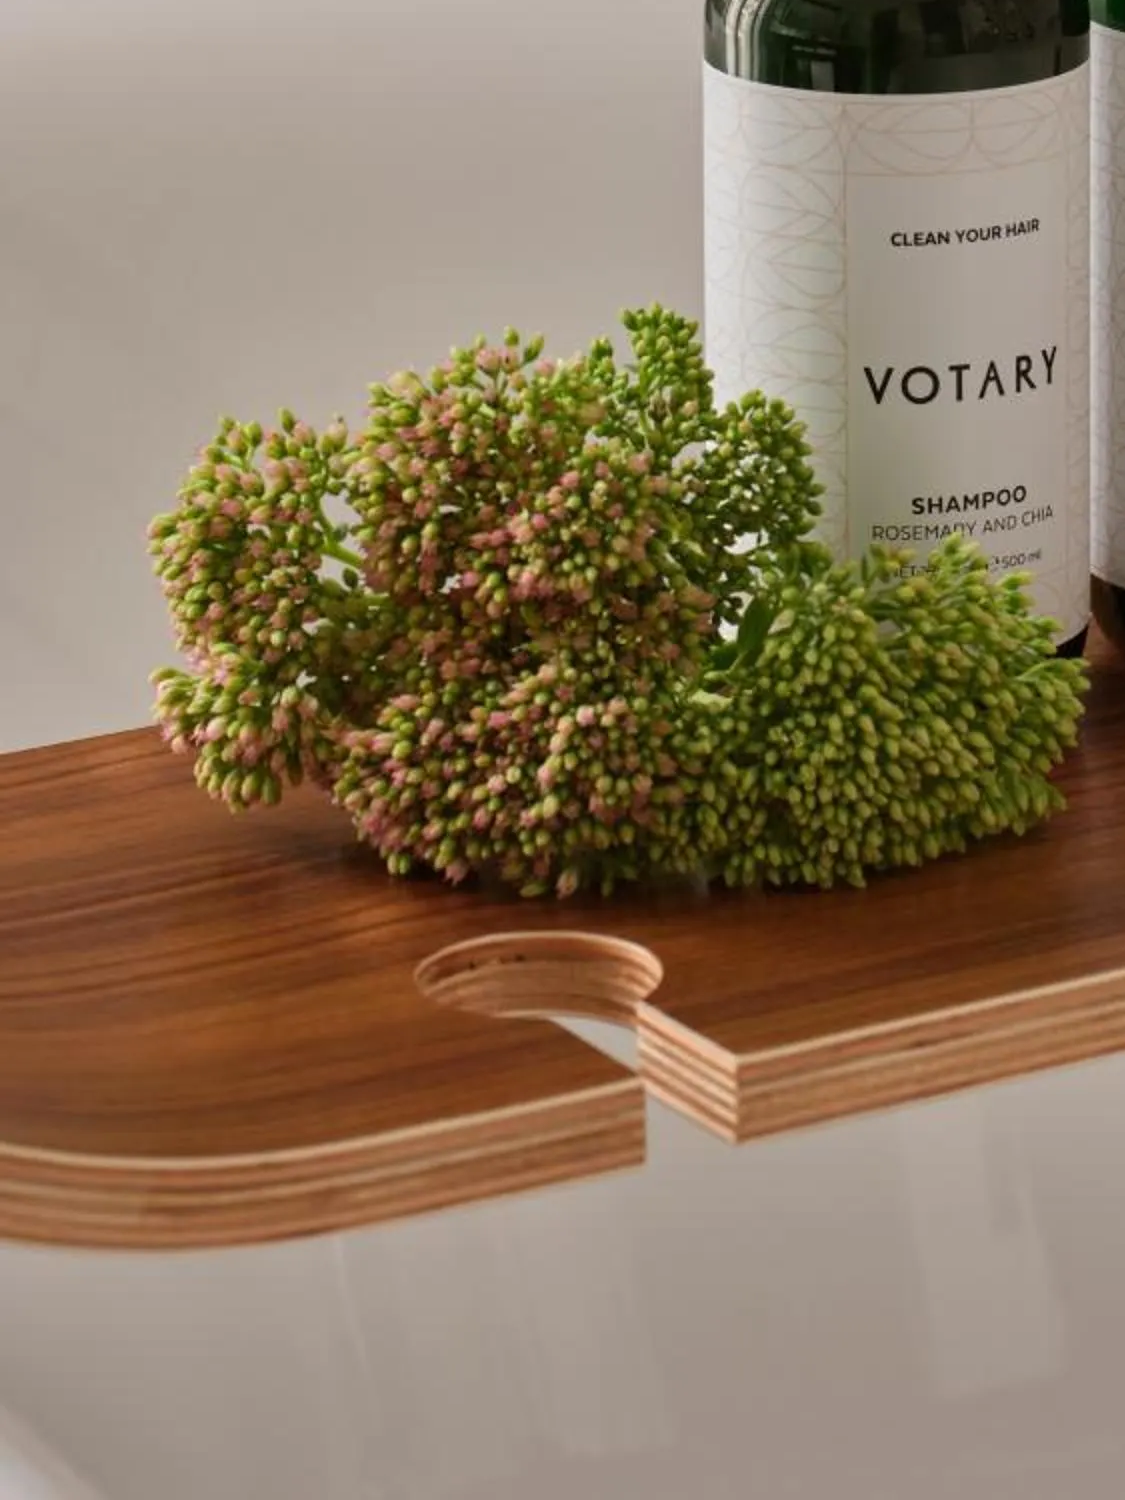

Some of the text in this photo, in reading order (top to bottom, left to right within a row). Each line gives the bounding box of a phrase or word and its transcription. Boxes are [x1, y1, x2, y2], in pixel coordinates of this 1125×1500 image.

[890, 217, 1041, 248] CLEAN YOUR HAIR
[863, 346, 1057, 405] VOTARY
[911, 485, 1027, 515] SHAMPOO
[982, 514, 1018, 534] AND
[1021, 504, 1054, 527] CHIA
[1001, 551, 1026, 570] 500
